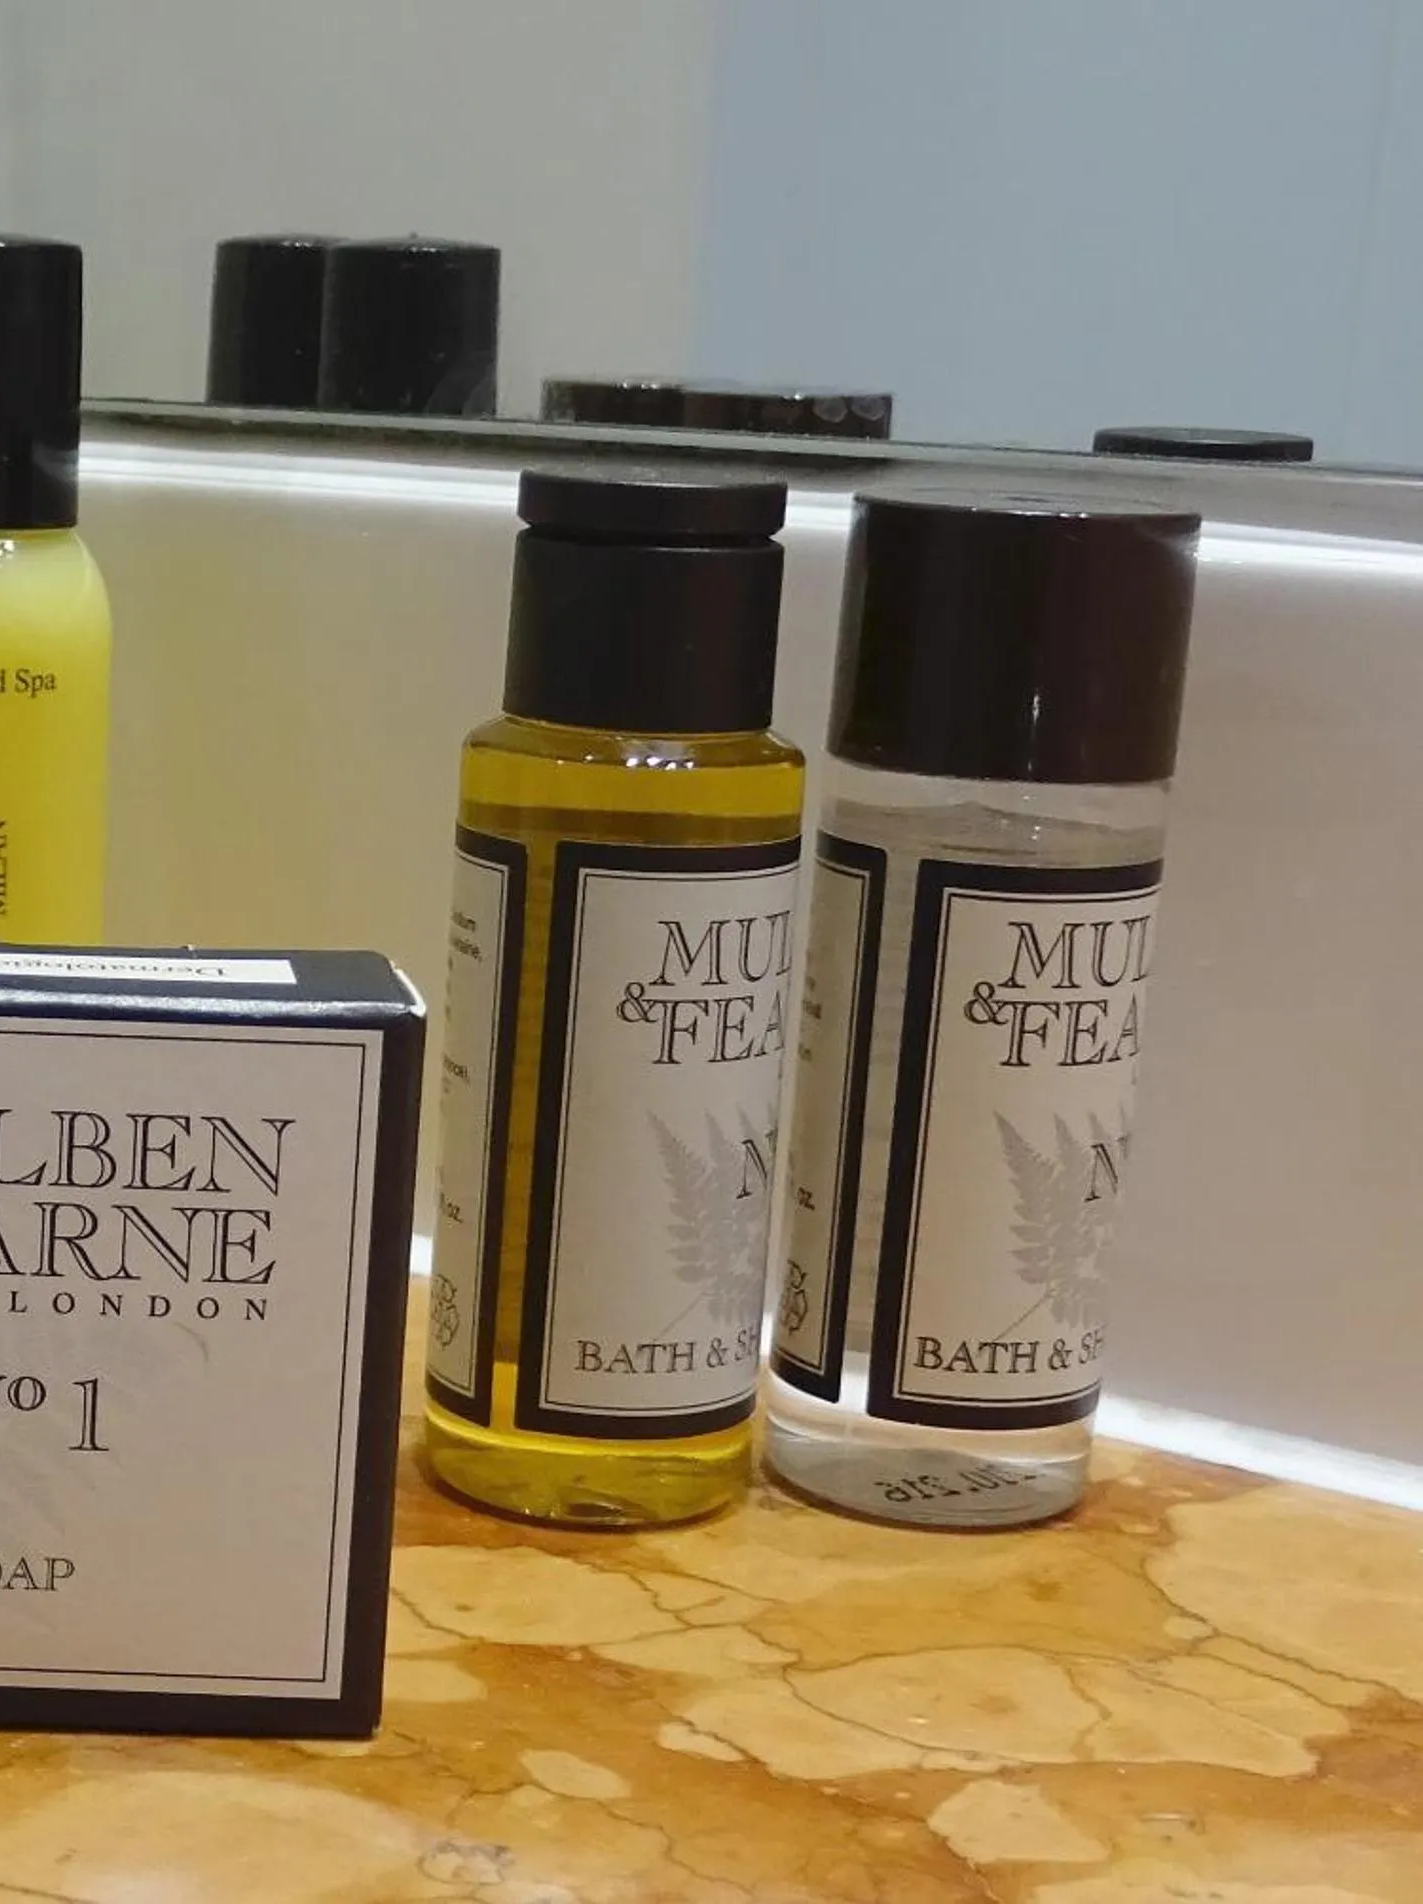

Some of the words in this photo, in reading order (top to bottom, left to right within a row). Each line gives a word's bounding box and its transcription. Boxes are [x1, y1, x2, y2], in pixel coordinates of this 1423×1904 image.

[14, 668, 57, 699] Spa
[8, 1290, 268, 1322] LONDON
[573, 1339, 697, 1375] BATH
[706, 1336, 729, 1369] &
[913, 1335, 1041, 1375] BATH
[1048, 1337, 1073, 1371] &
